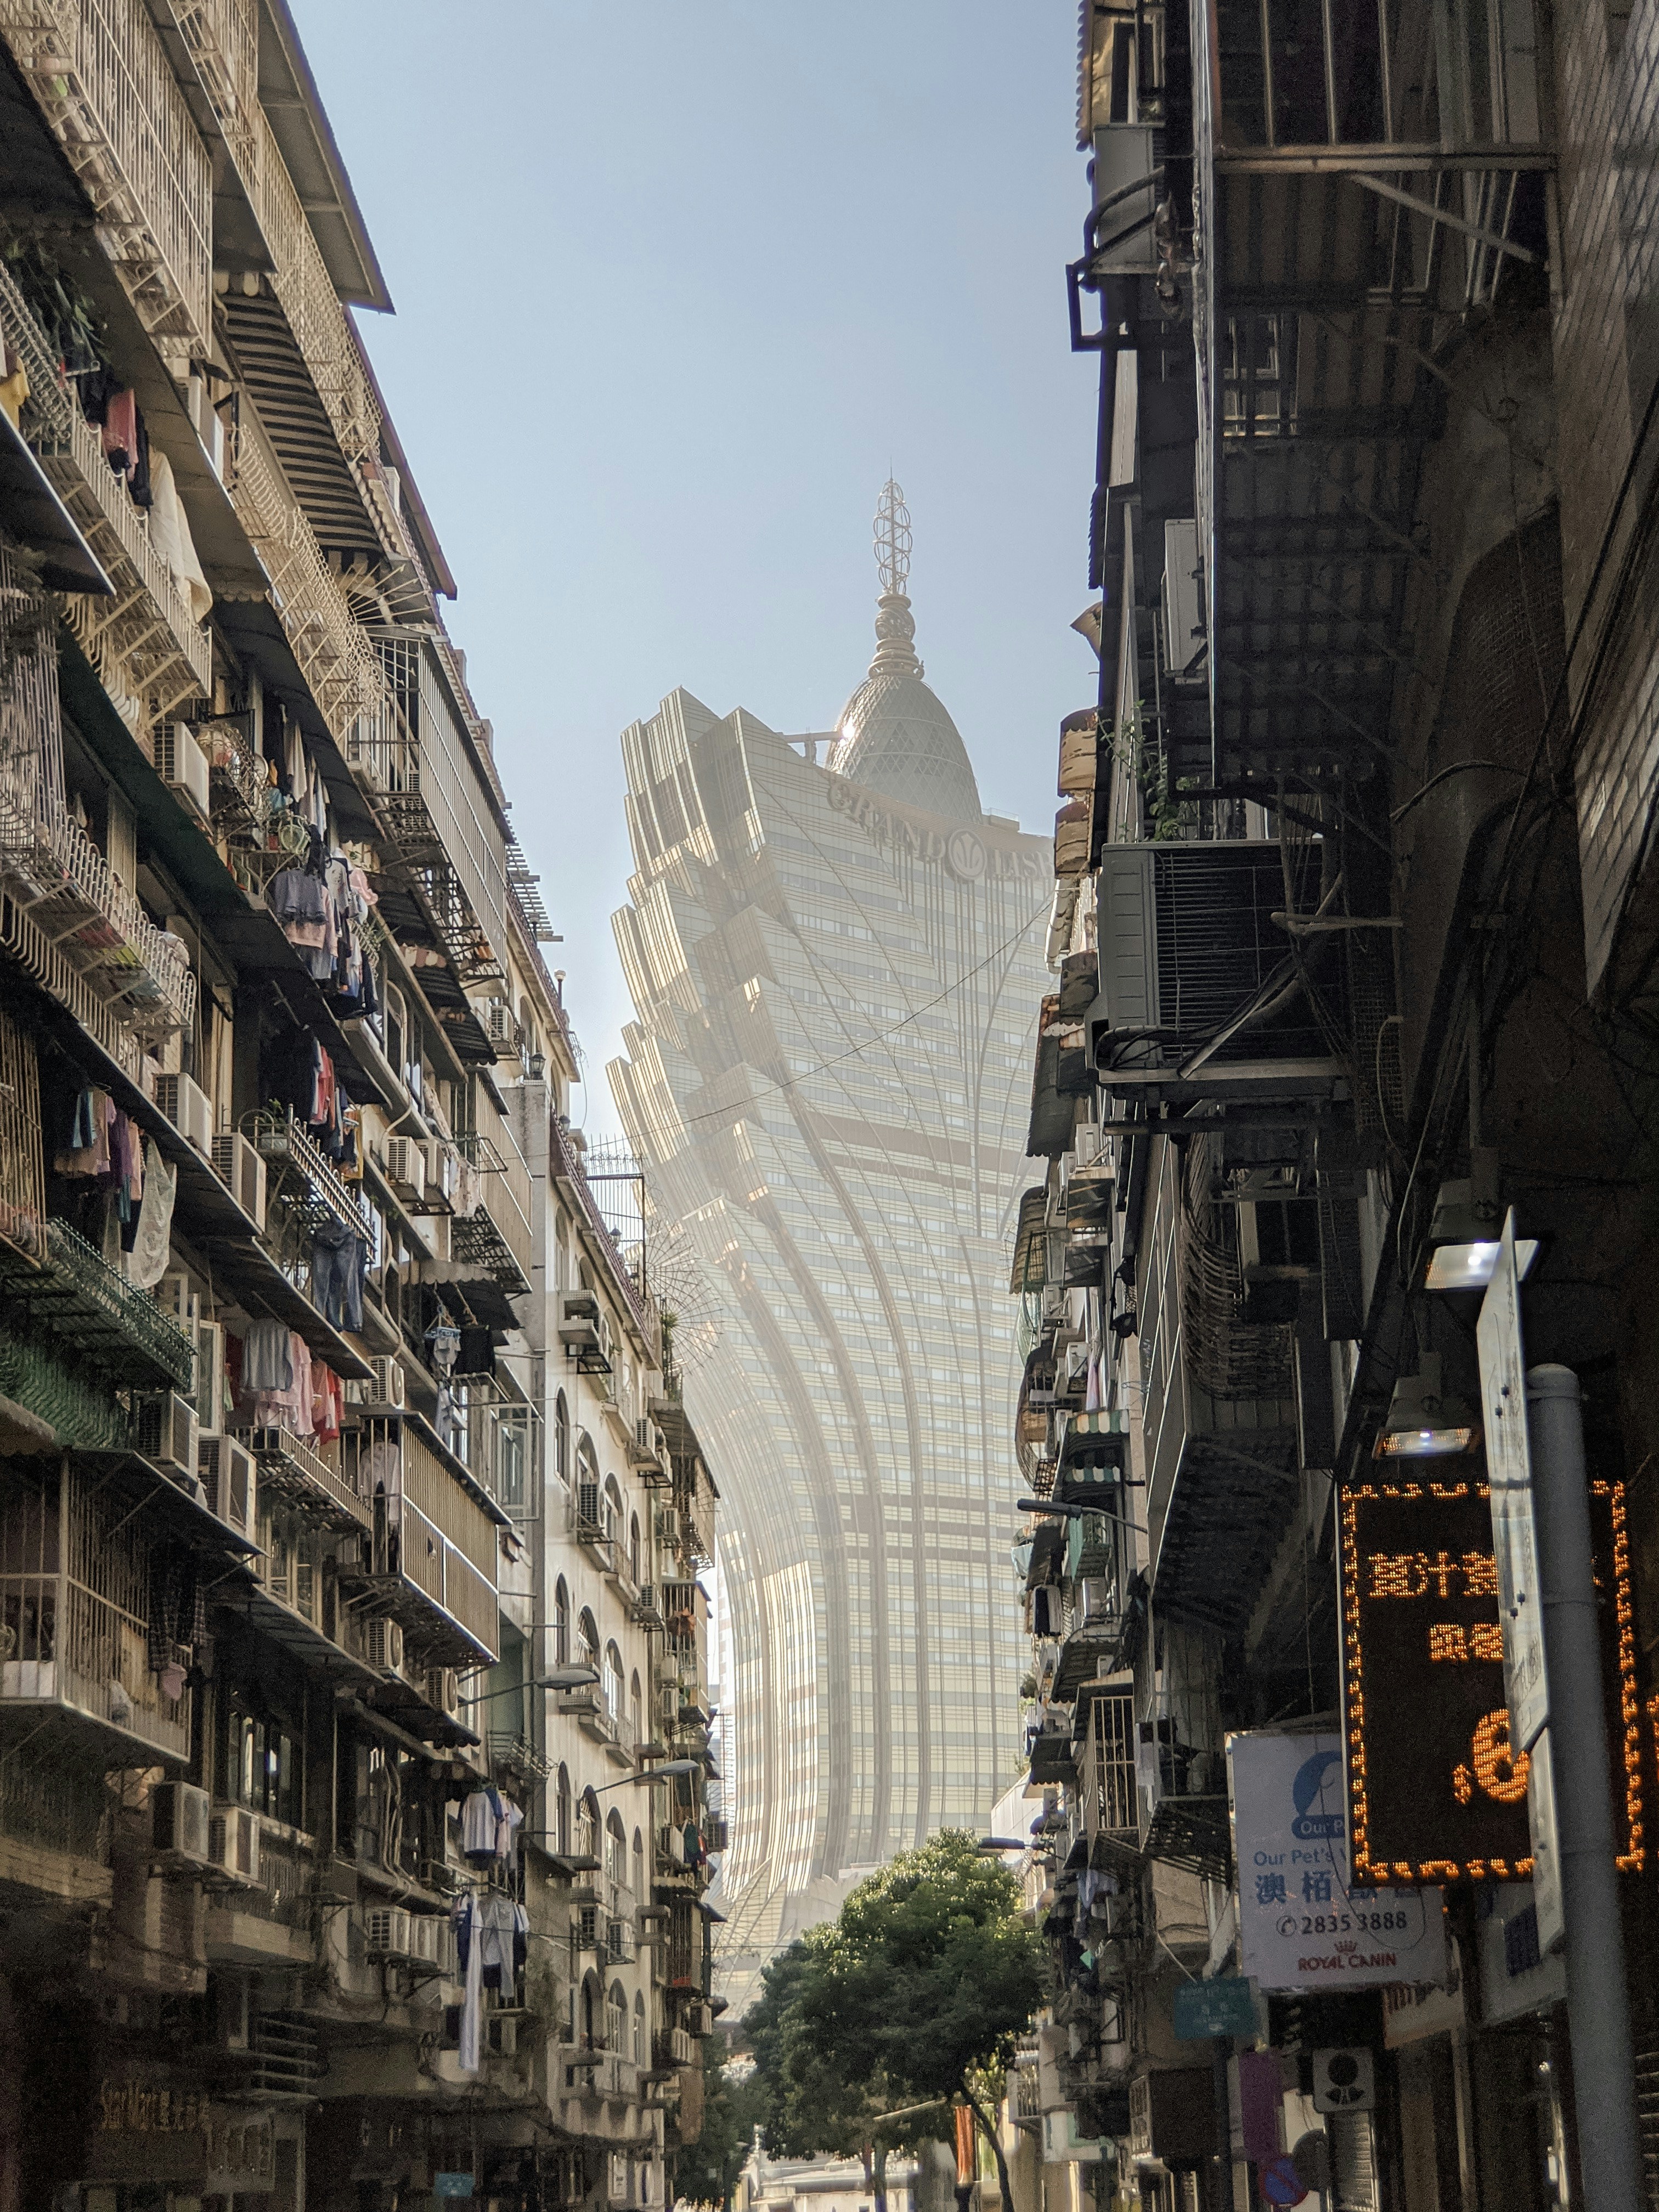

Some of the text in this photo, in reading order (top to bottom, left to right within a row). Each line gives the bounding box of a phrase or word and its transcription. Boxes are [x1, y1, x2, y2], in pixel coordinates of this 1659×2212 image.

[828, 782, 946, 860] GRAND
[1254, 1851, 1285, 1866] Our
[1291, 1848, 1334, 1864] Pet's
[1302, 1912, 1407, 1934] 2835 3888
[1299, 1953, 1397, 1971] ROYAL CANIN
